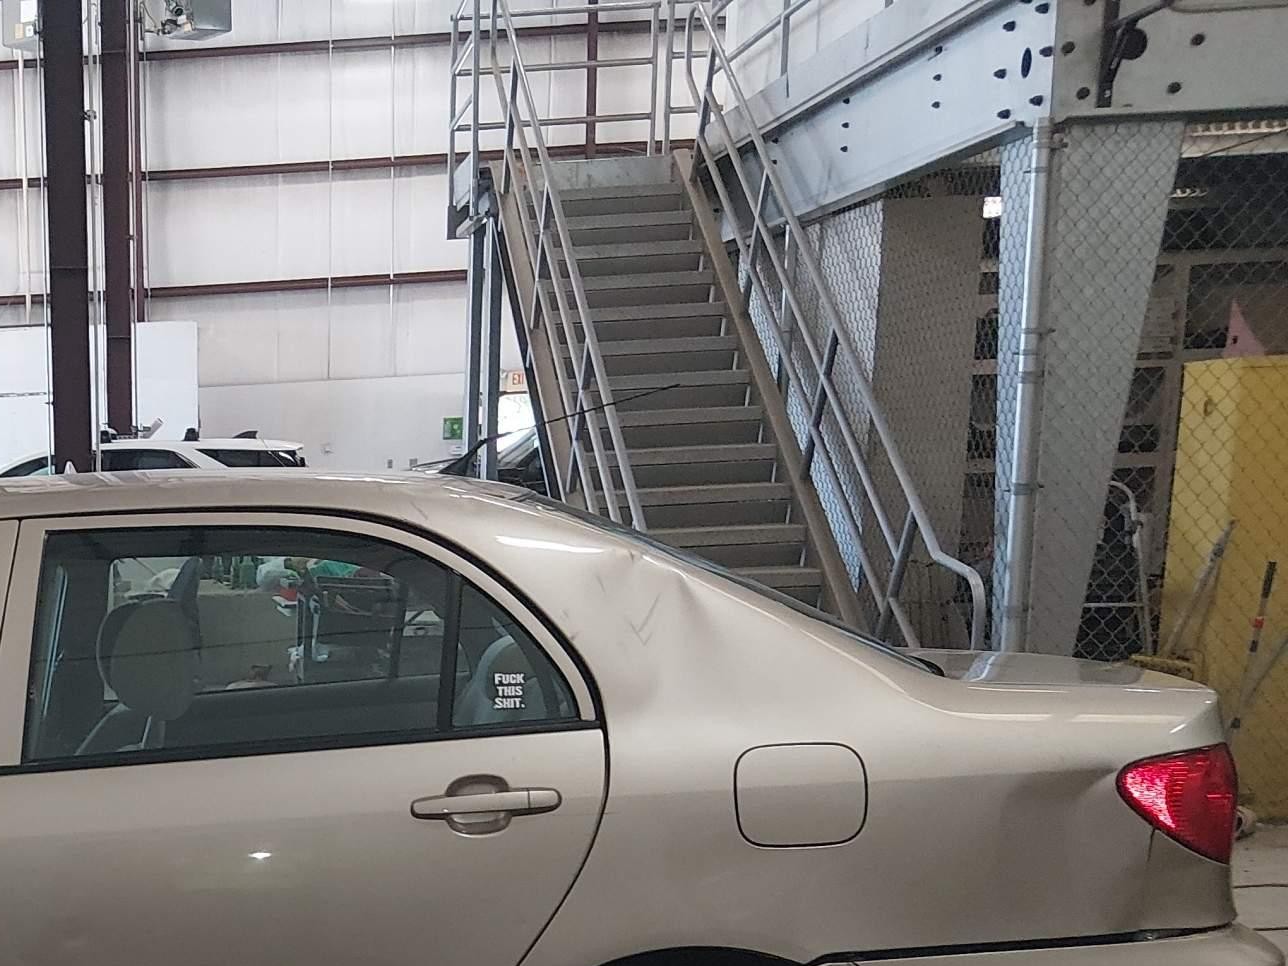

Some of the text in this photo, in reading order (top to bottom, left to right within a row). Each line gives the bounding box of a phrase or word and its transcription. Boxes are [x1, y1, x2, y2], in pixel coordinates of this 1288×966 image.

[494, 673, 525, 685] FUCK
[496, 686, 523, 697] THIS
[493, 697, 526, 709] SHIT.
